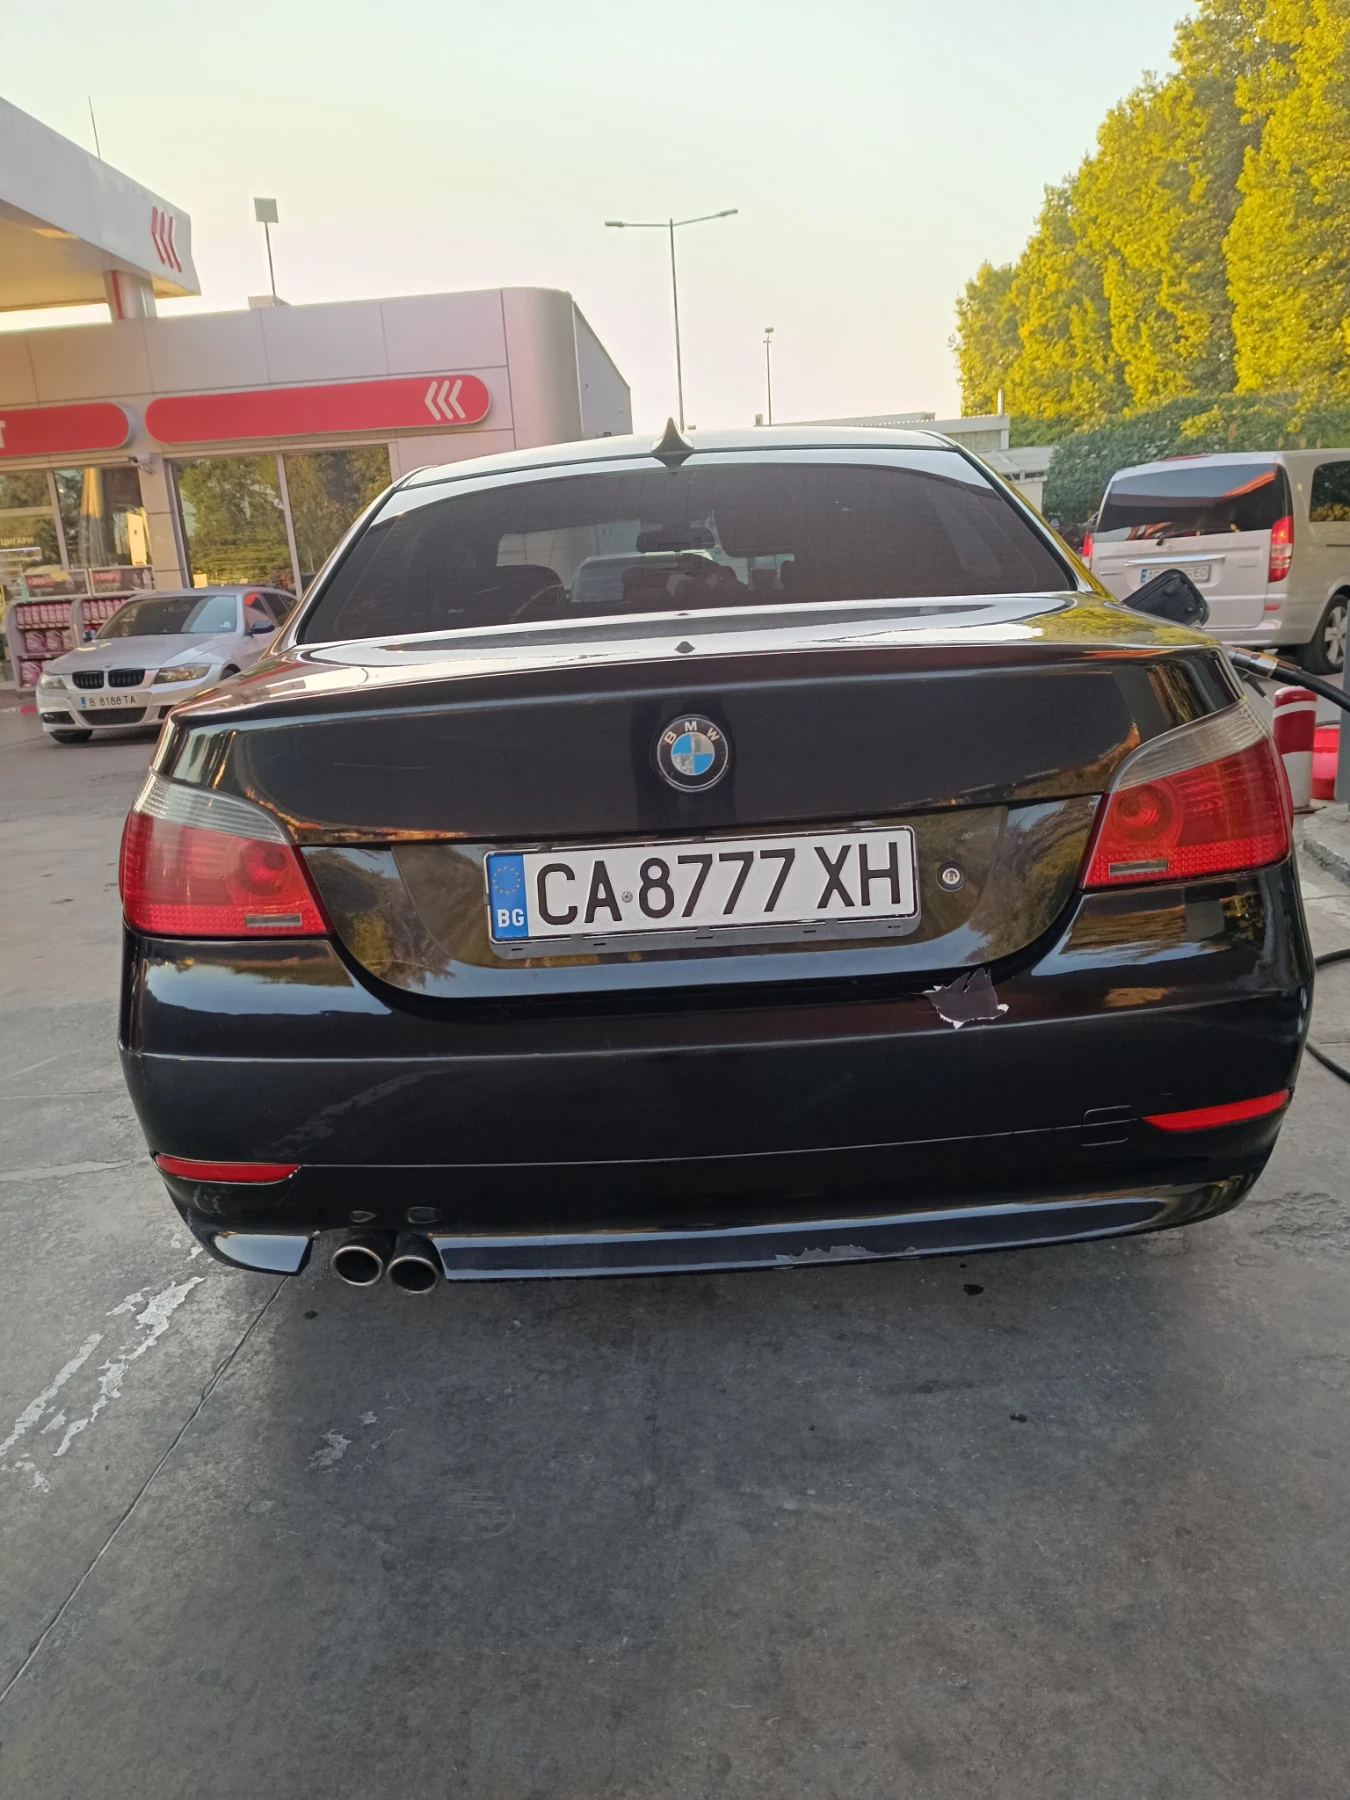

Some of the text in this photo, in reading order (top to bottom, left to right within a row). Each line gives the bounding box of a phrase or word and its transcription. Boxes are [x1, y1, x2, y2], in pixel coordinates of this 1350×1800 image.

[122, 695, 136, 704] TA
[664, 720, 721, 745] BMW
[536, 841, 902, 926] CA 8777 XH
[496, 908, 525, 928] BG
